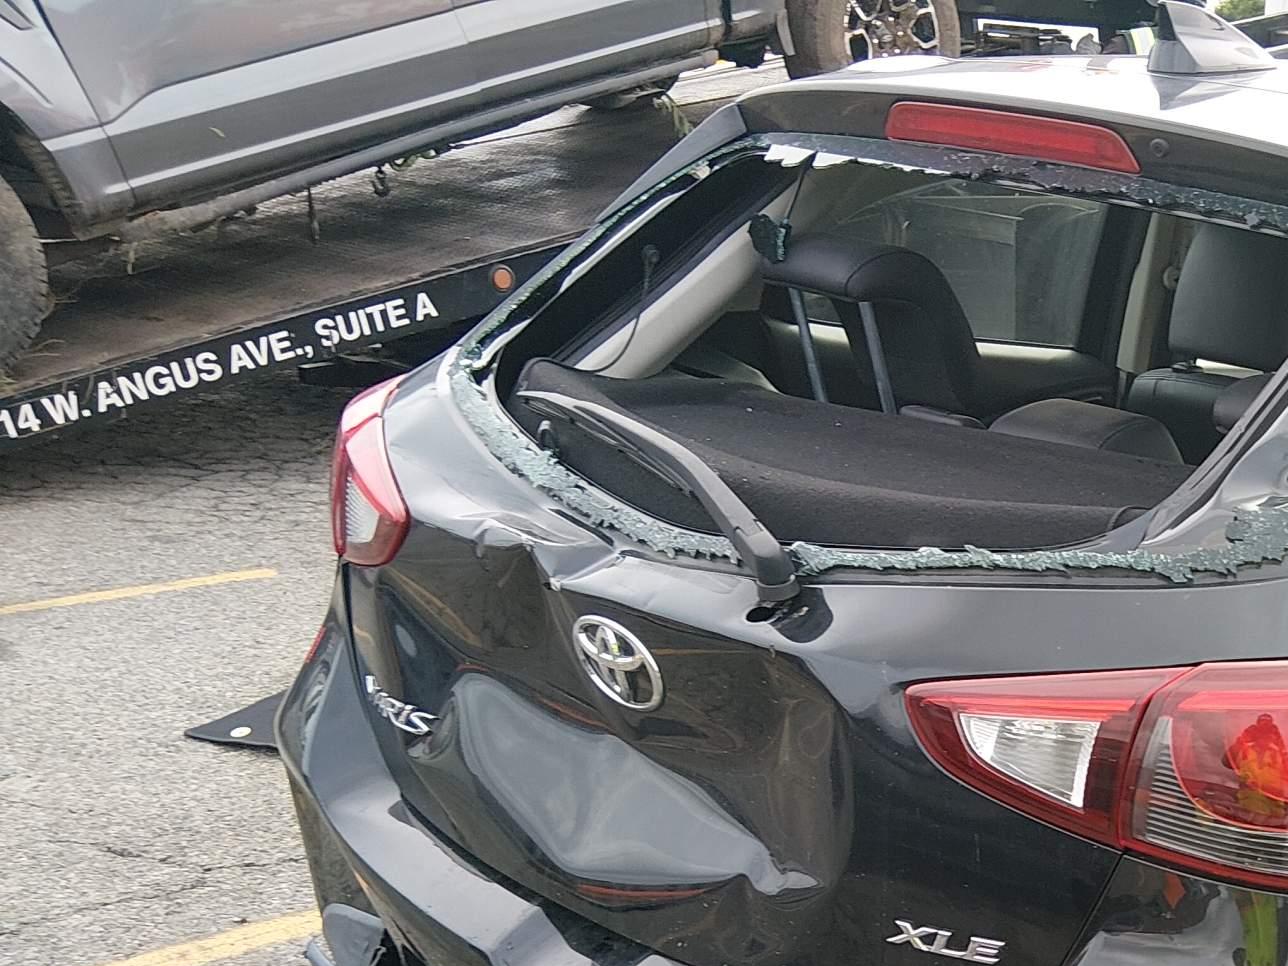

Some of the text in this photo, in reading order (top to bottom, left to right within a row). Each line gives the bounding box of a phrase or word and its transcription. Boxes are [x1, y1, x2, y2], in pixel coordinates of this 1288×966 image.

[40, 390, 92, 425] W.
[97, 352, 223, 413] ANGUS
[230, 330, 314, 374] AVE.,
[314, 299, 411, 347] SUITE
[415, 292, 440, 322] A
[885, 919, 1006, 965] XLE
